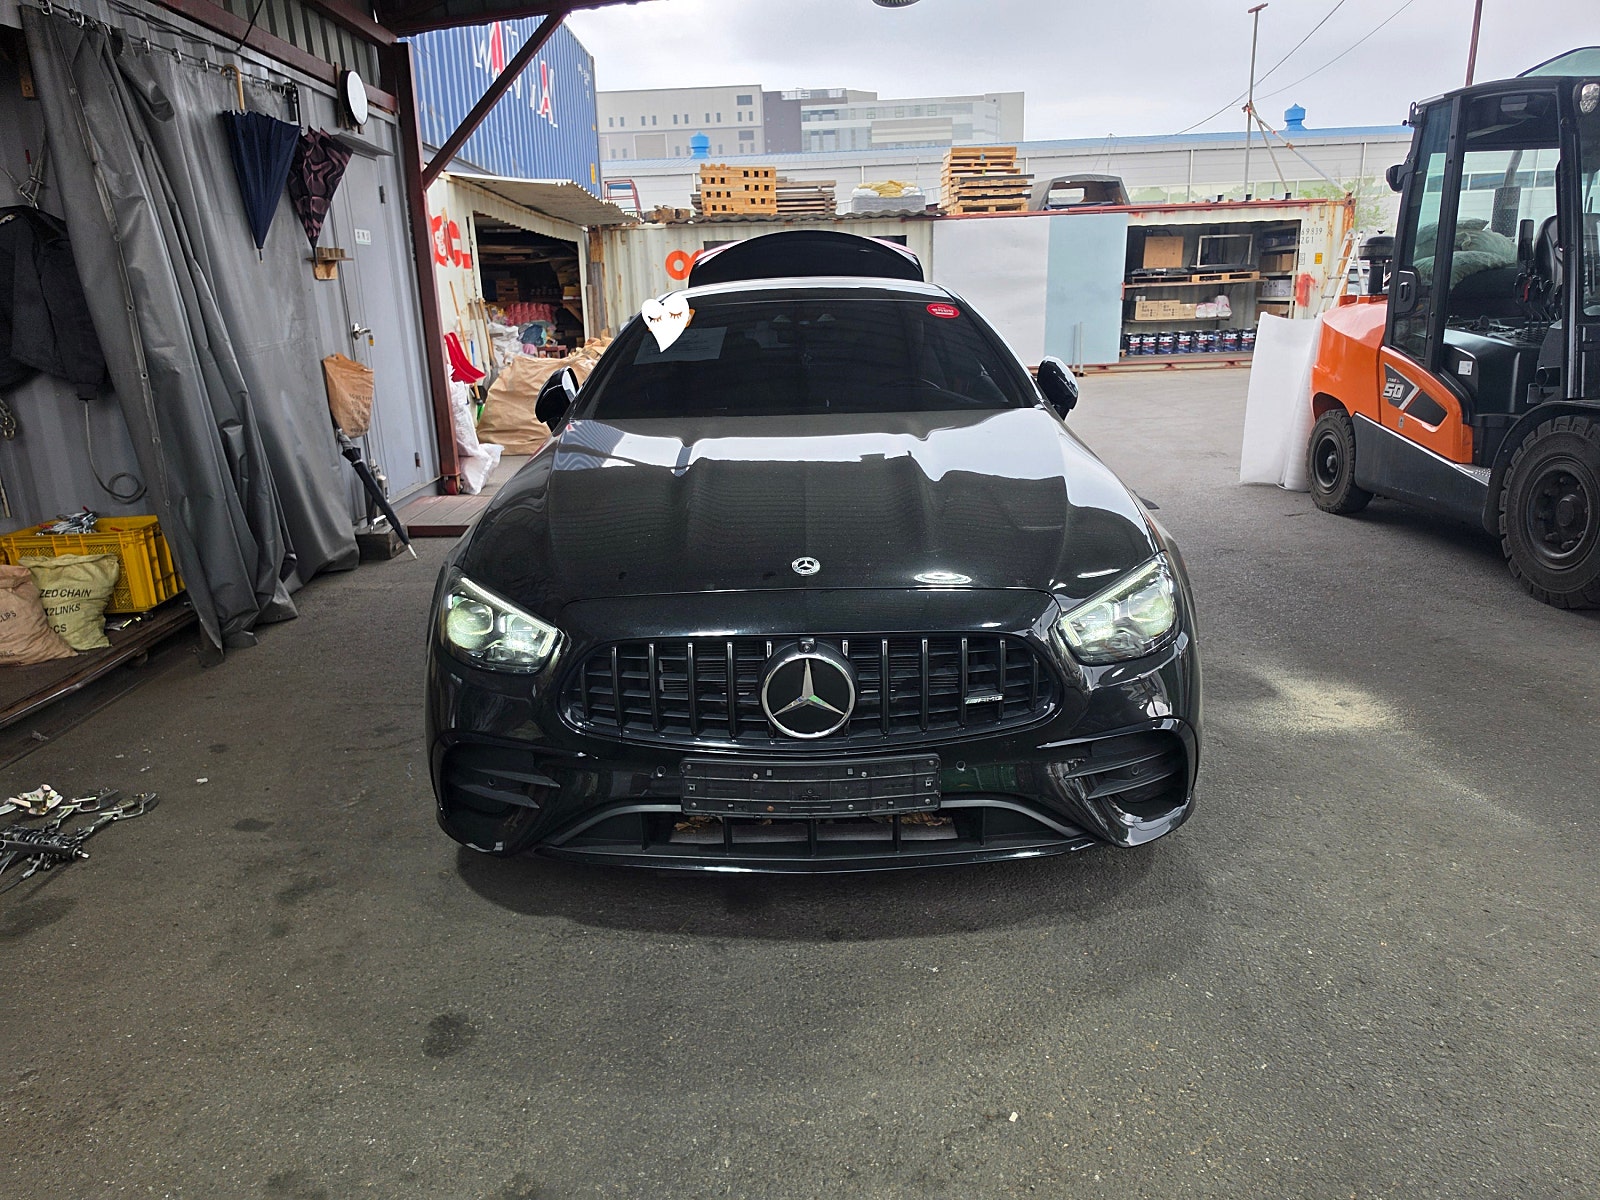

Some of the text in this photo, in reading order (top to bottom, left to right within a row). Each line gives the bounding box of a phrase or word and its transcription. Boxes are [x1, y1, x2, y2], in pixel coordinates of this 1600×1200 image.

[60, 588, 92, 598] CHAIN
[0, 610, 17, 623] LIPS
[50, 623, 67, 634] CS
